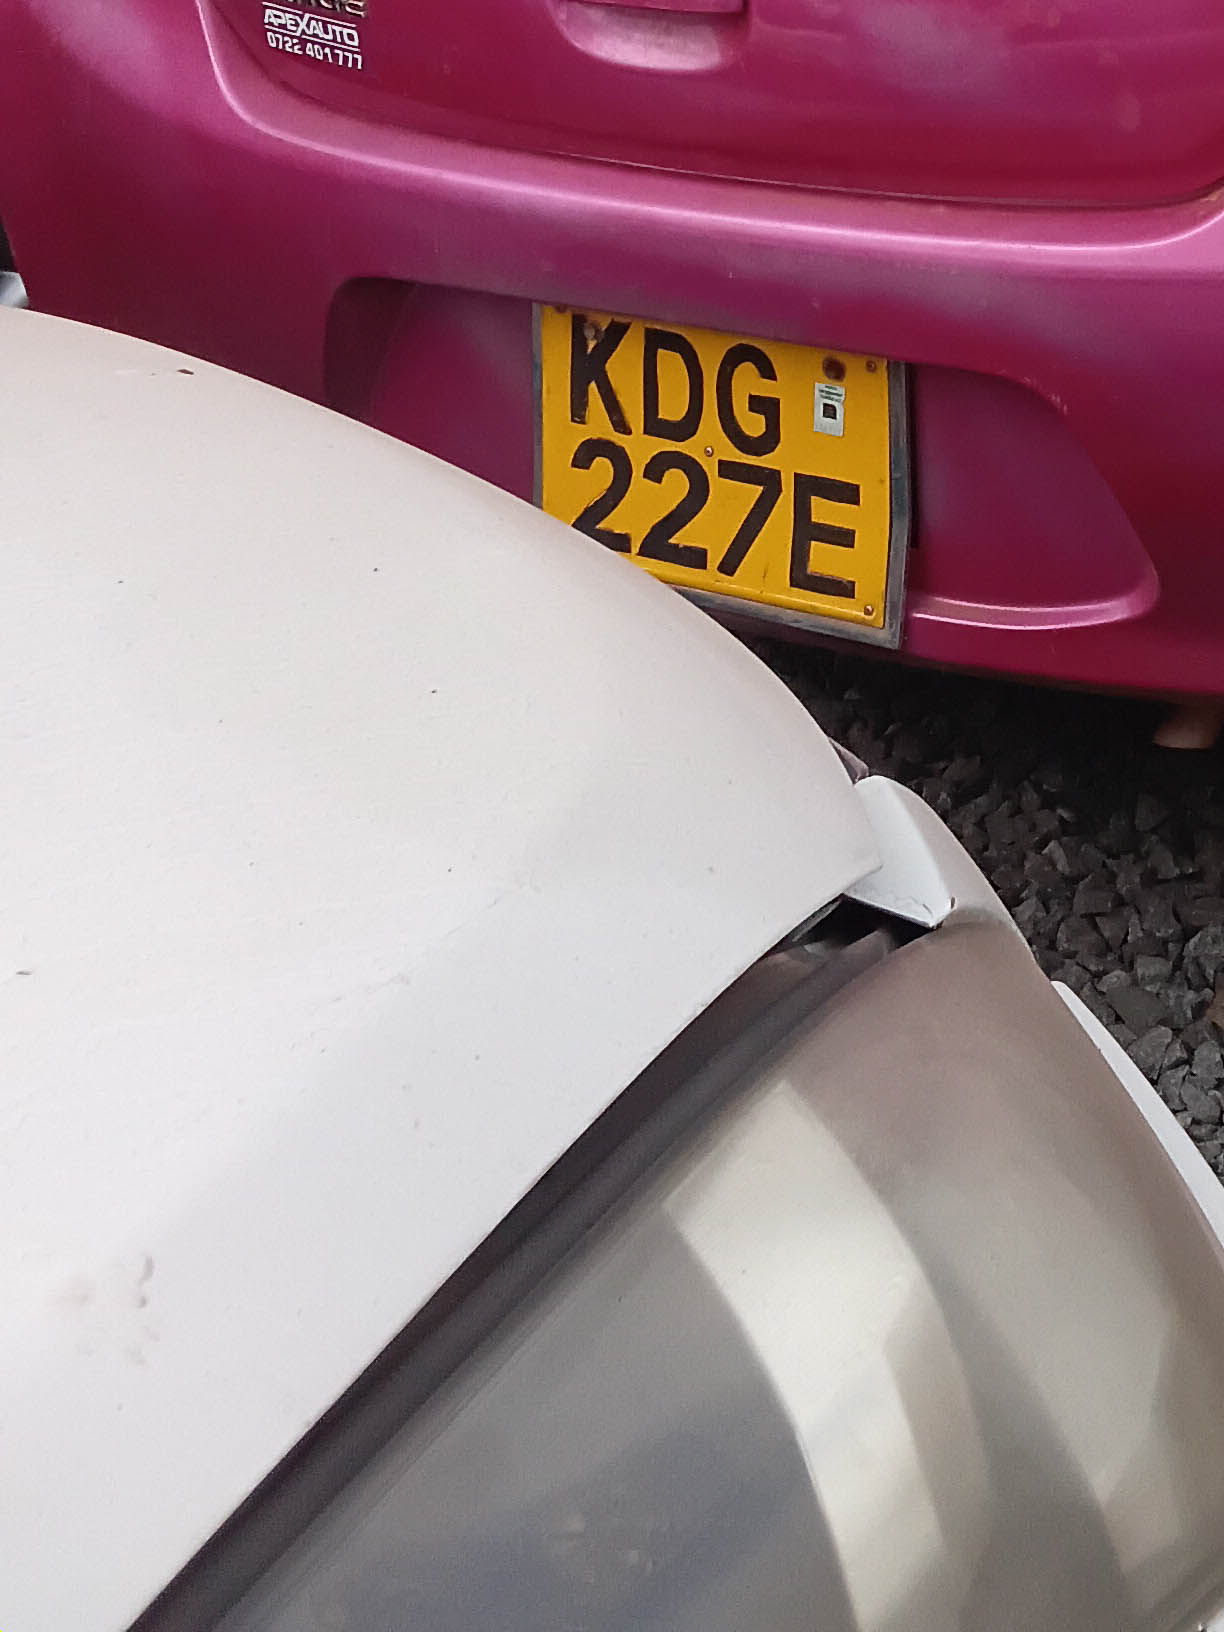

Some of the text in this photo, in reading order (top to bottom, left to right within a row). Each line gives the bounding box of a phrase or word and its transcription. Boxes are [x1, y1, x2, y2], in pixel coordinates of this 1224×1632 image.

[267, 32, 363, 70] 0722 401 777
[570, 313, 781, 457] KDG
[570, 437, 861, 599] 227E
